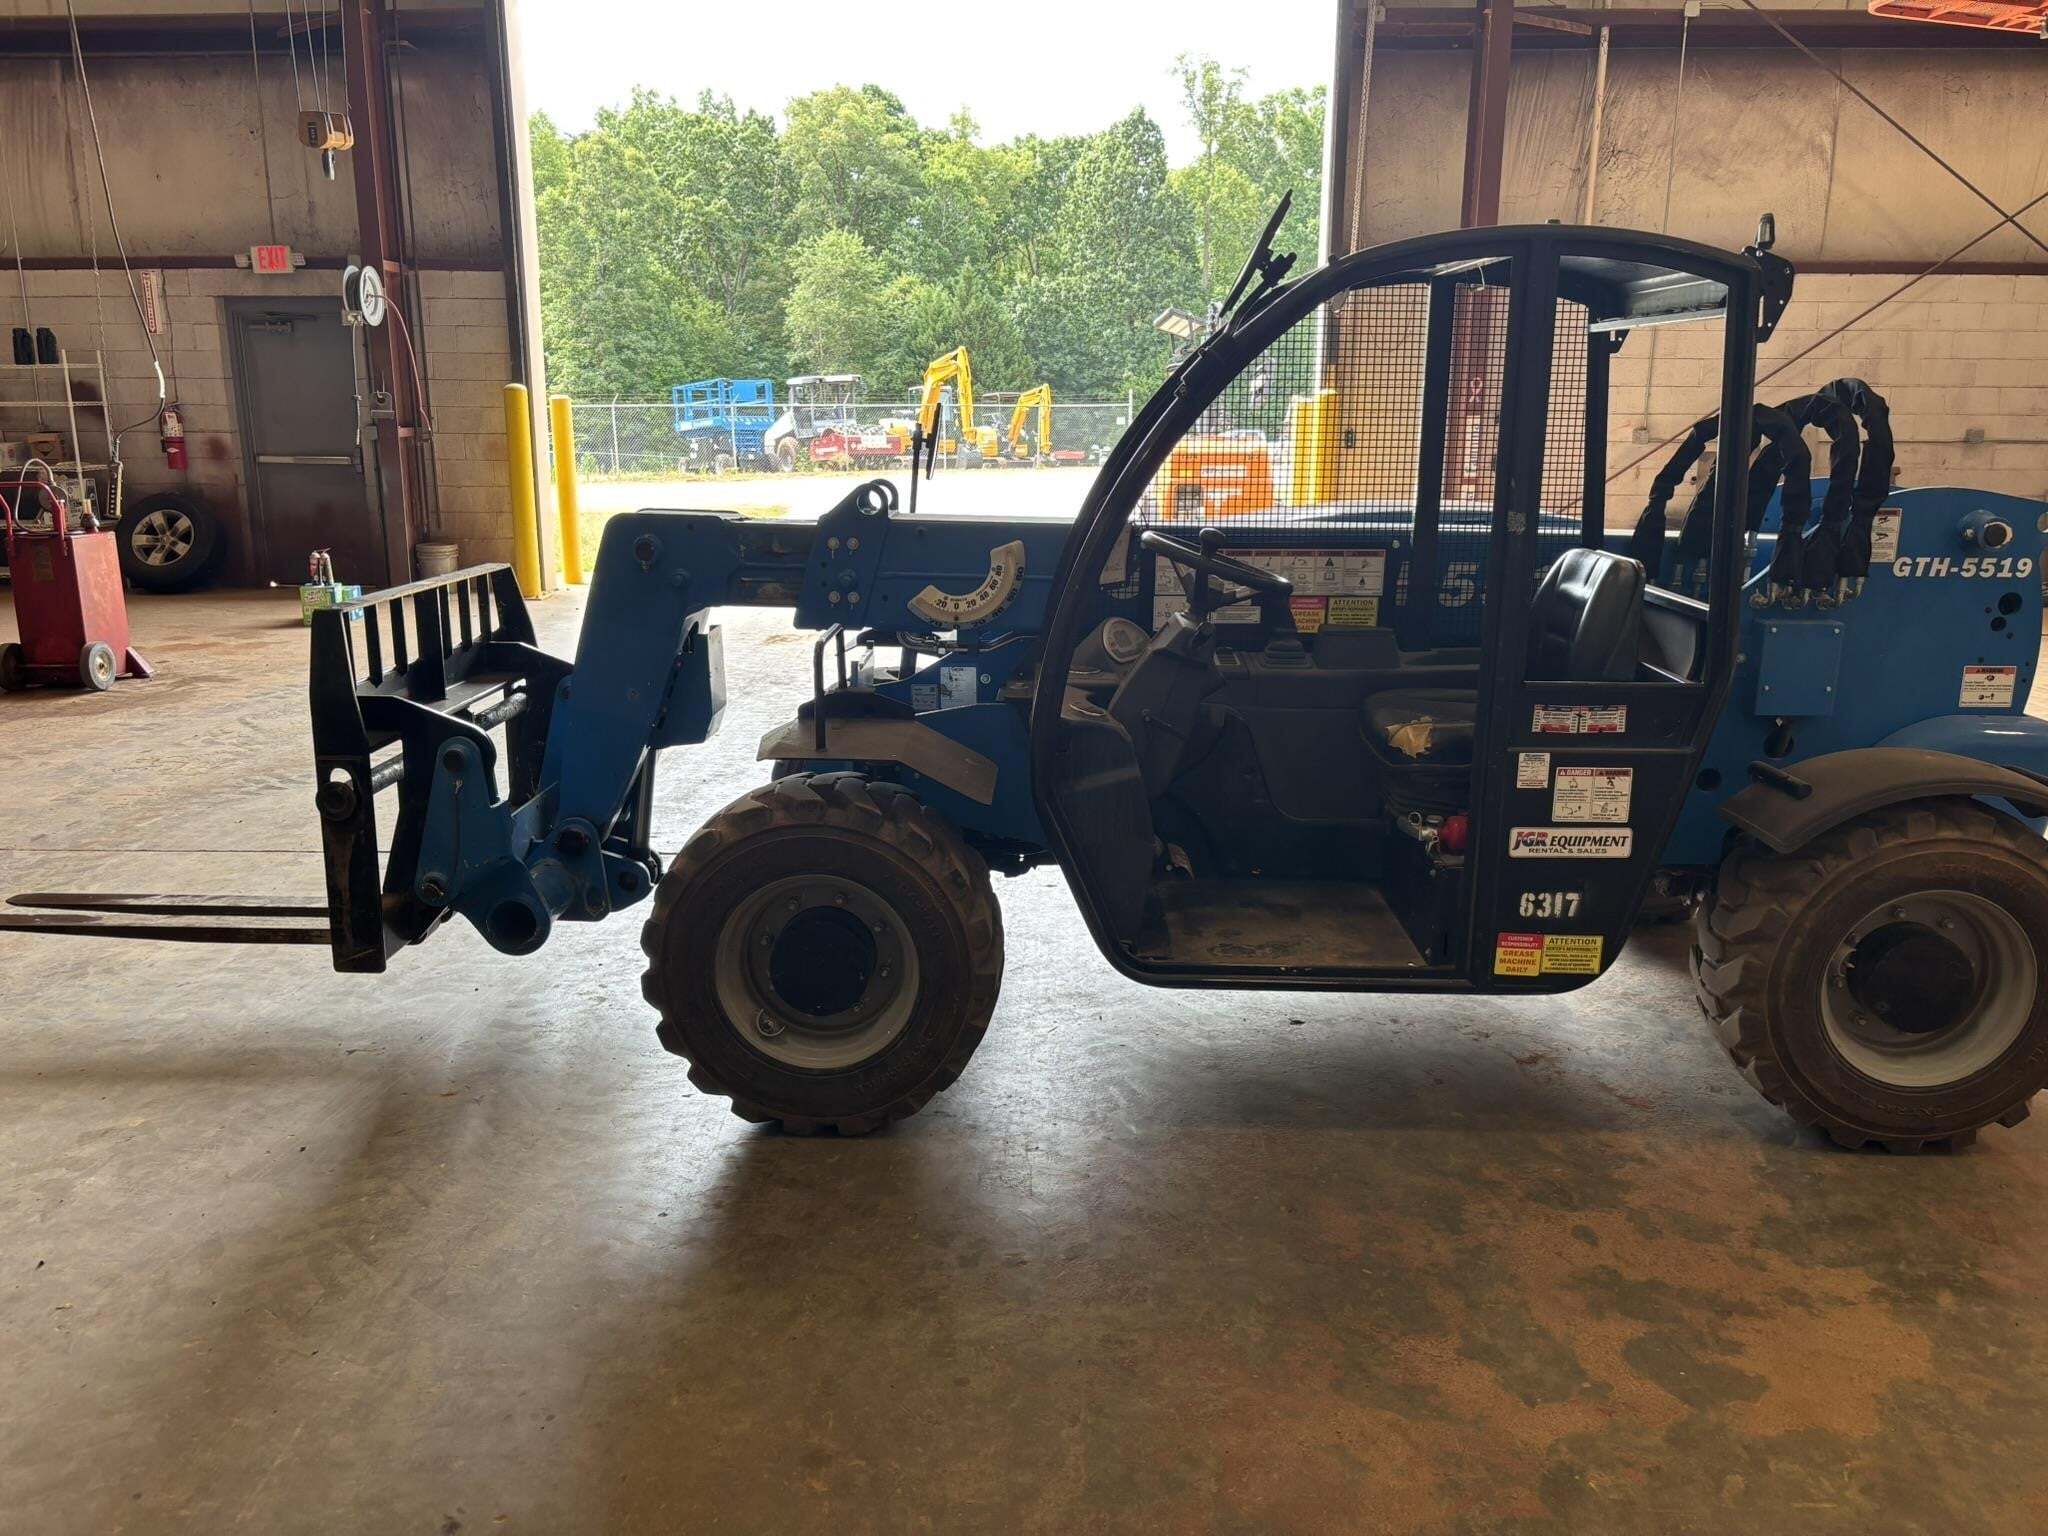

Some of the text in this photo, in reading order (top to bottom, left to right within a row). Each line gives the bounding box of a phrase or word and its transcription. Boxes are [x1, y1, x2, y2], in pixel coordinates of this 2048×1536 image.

[258, 246, 288, 271] EXIT
[1892, 556, 2033, 578] GTH-5519
[989, 579, 999, 591] 60
[965, 598, 977, 609] 20
[1511, 832, 1629, 850] JGR EQUIPMENT
[1519, 892, 1581, 918] 6317
[1548, 937, 1597, 945] ATTENTION
[1502, 949, 1536, 957] GREASE
[1498, 957, 1537, 966] MACHINE
